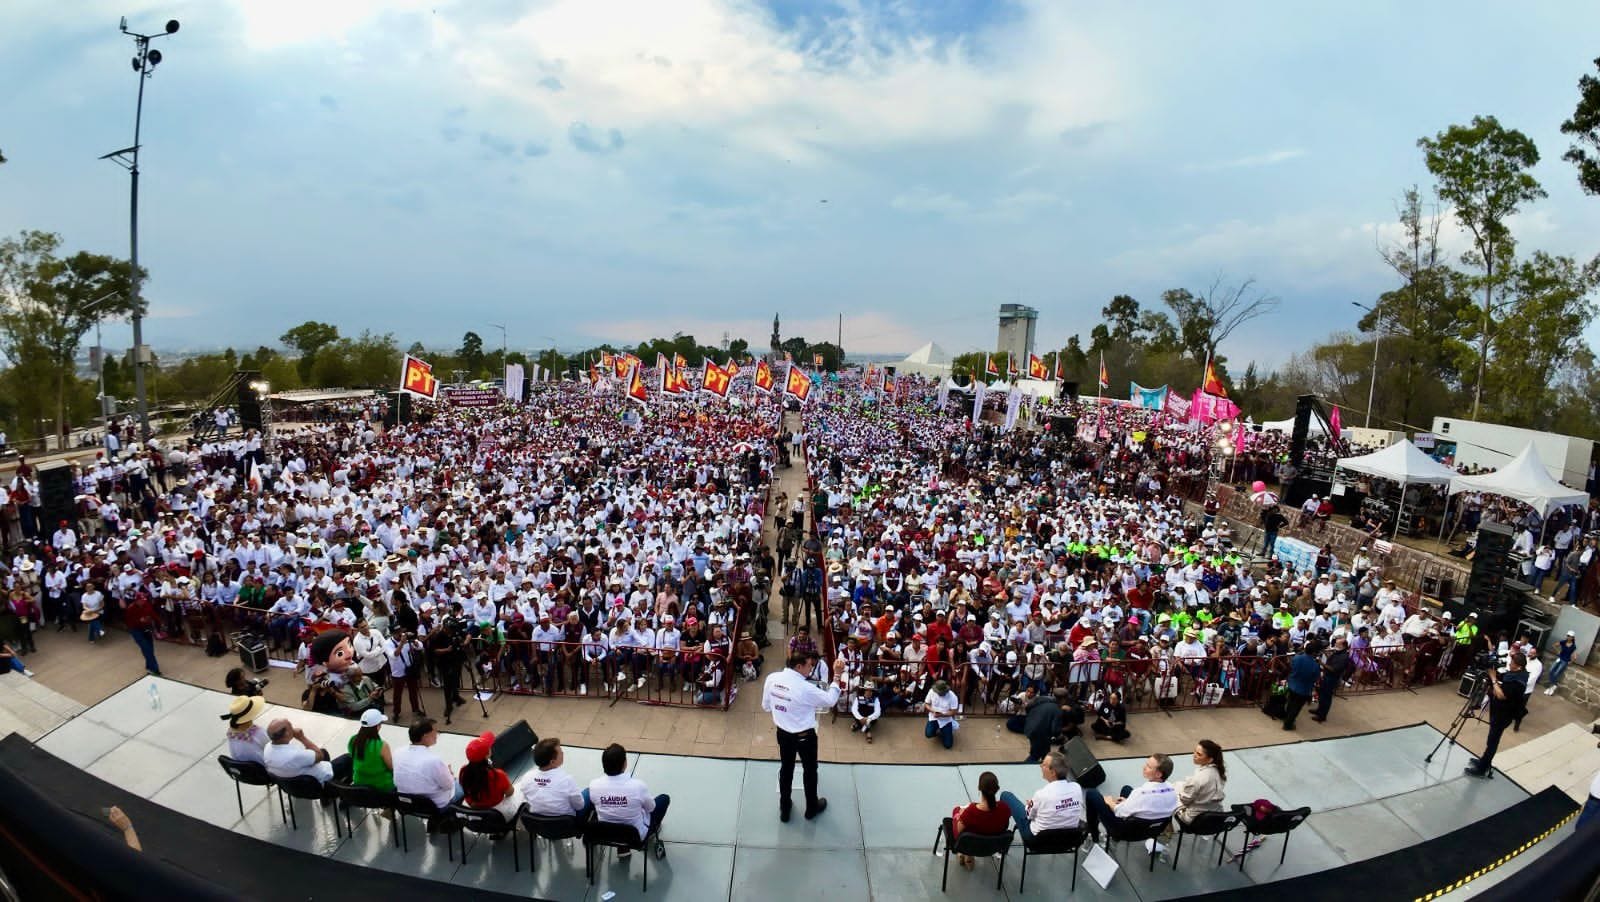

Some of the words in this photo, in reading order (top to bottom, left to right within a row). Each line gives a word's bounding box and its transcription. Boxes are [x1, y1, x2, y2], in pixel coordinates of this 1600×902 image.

[407, 366, 433, 392] PT
[1030, 360, 1047, 378] PT
[704, 370, 729, 392] PT
[788, 373, 810, 397] PT
